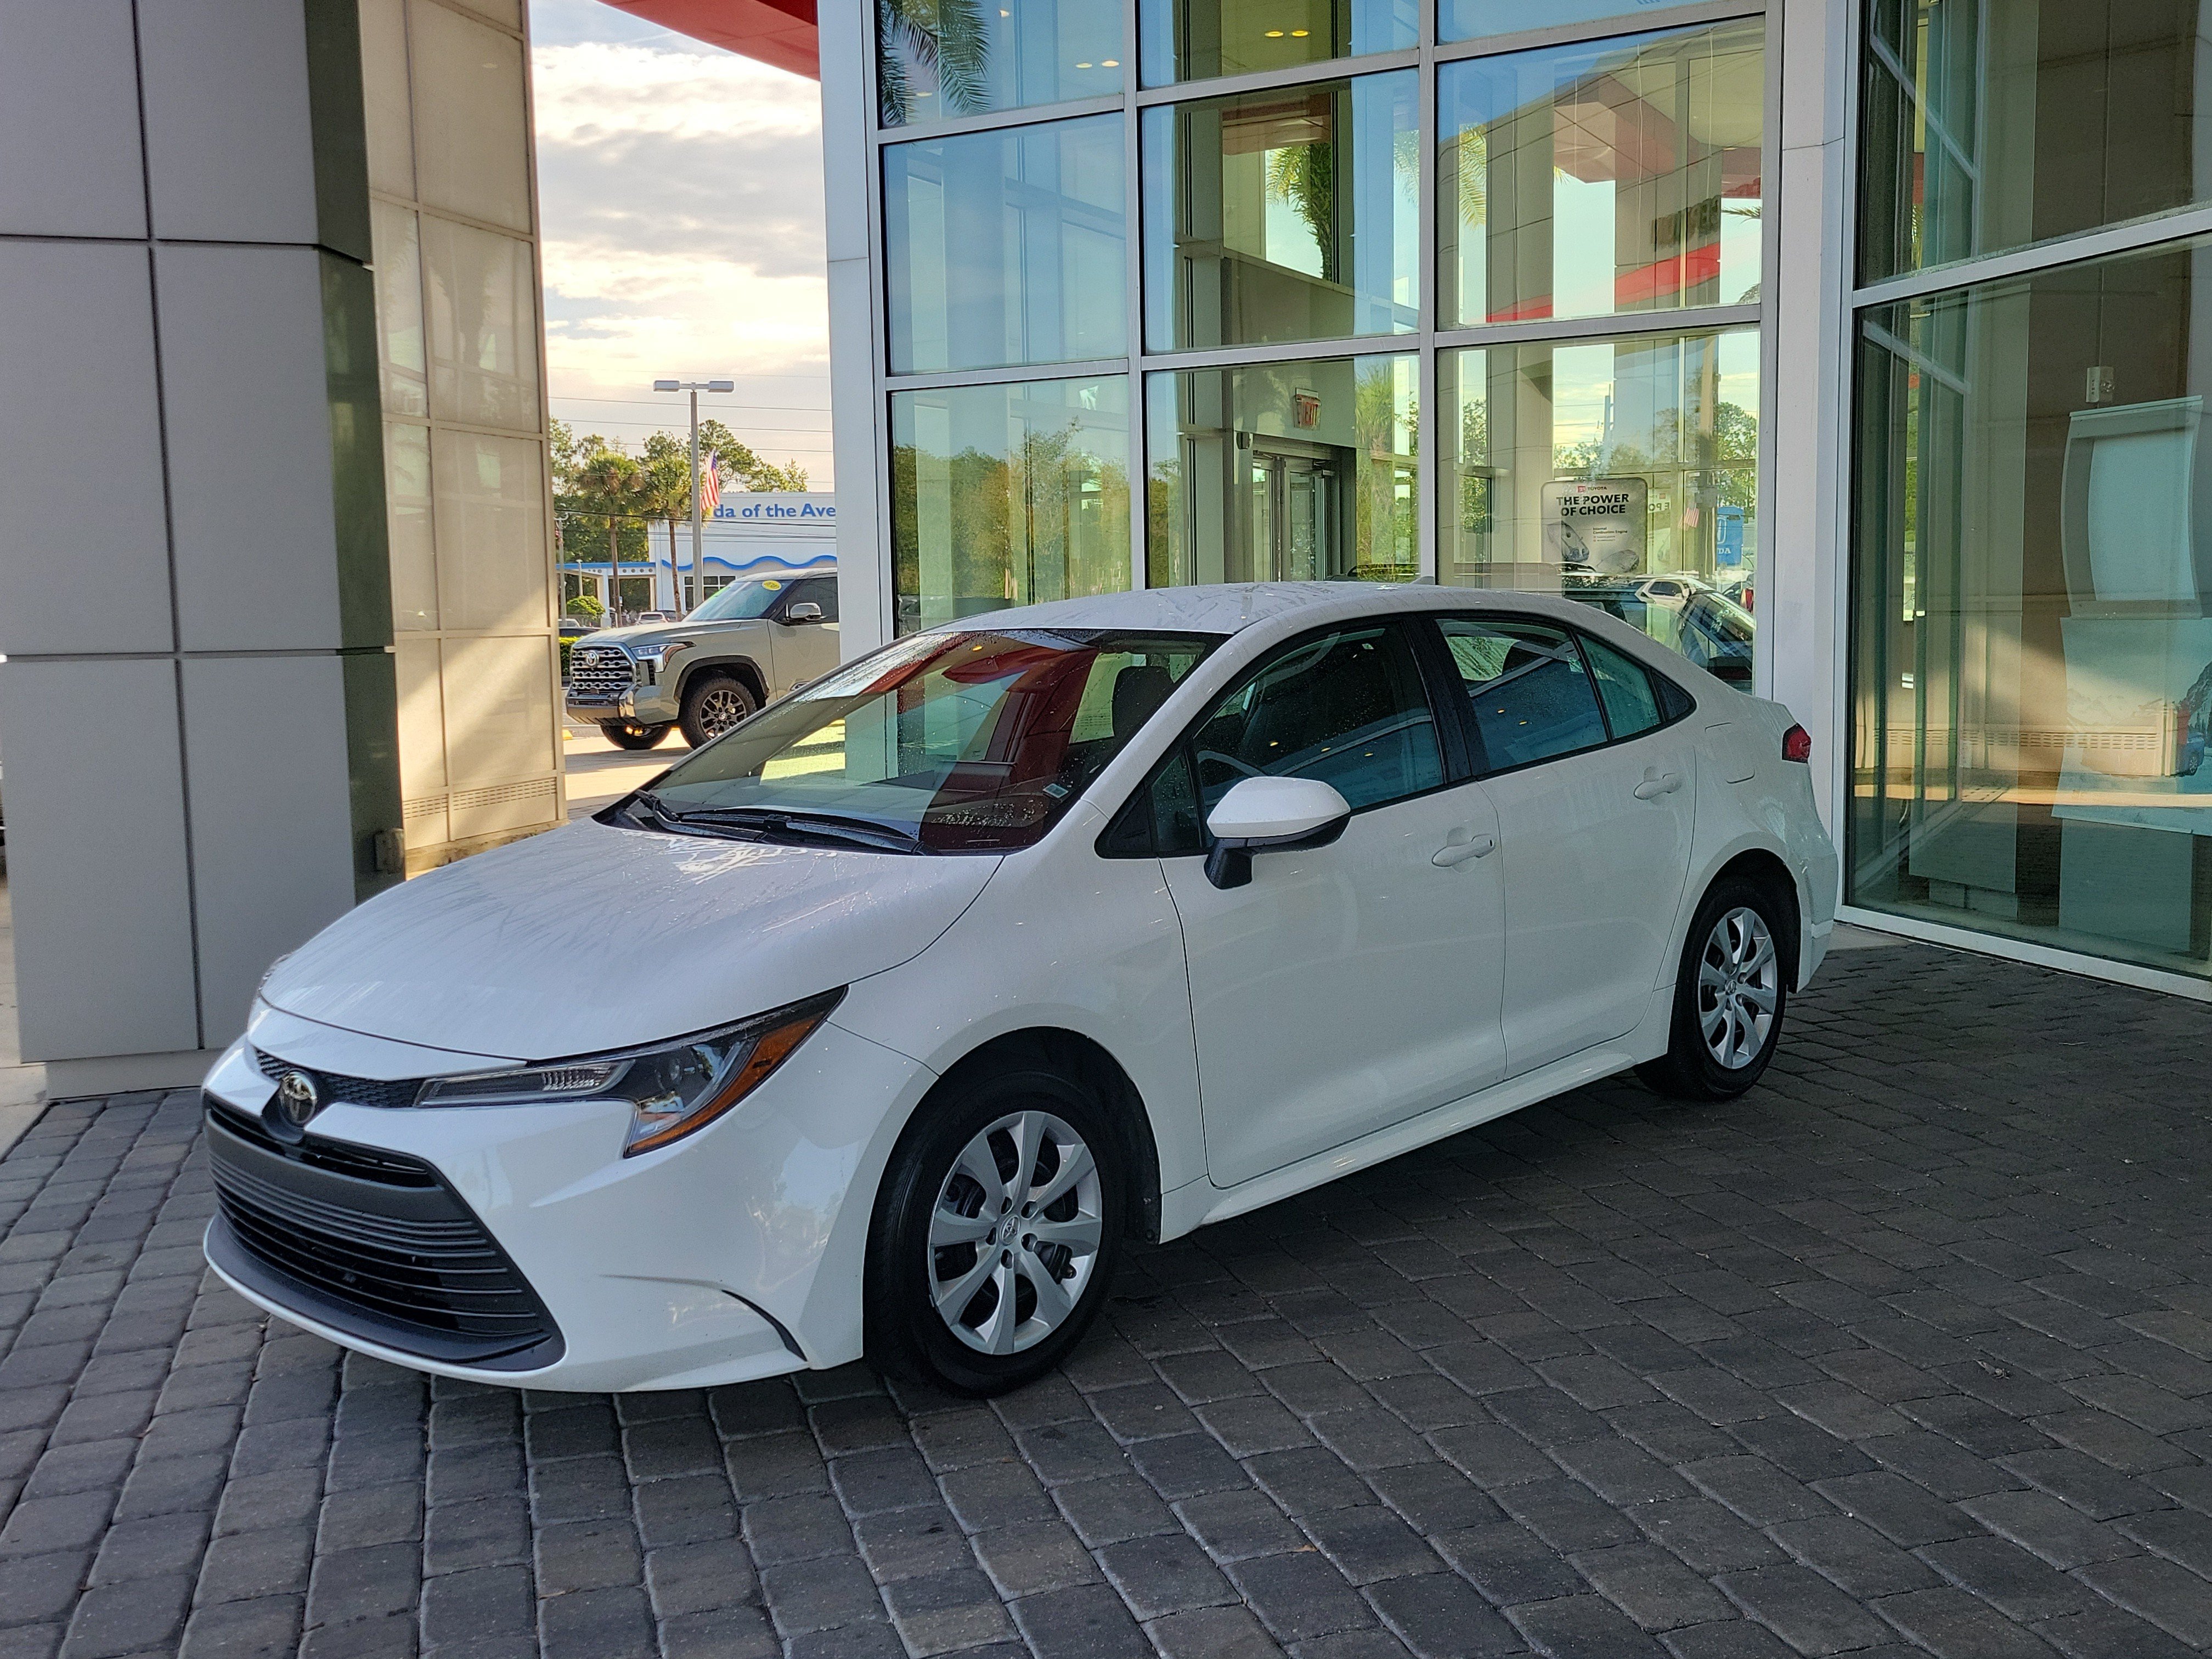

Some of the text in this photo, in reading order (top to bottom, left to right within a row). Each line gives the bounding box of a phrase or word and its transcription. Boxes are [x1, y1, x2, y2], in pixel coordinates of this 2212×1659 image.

[1556, 493, 1629, 506] THE POWER
[714, 503, 836, 518] da of the Ave
[1561, 504, 1626, 516] OF CHOICE
